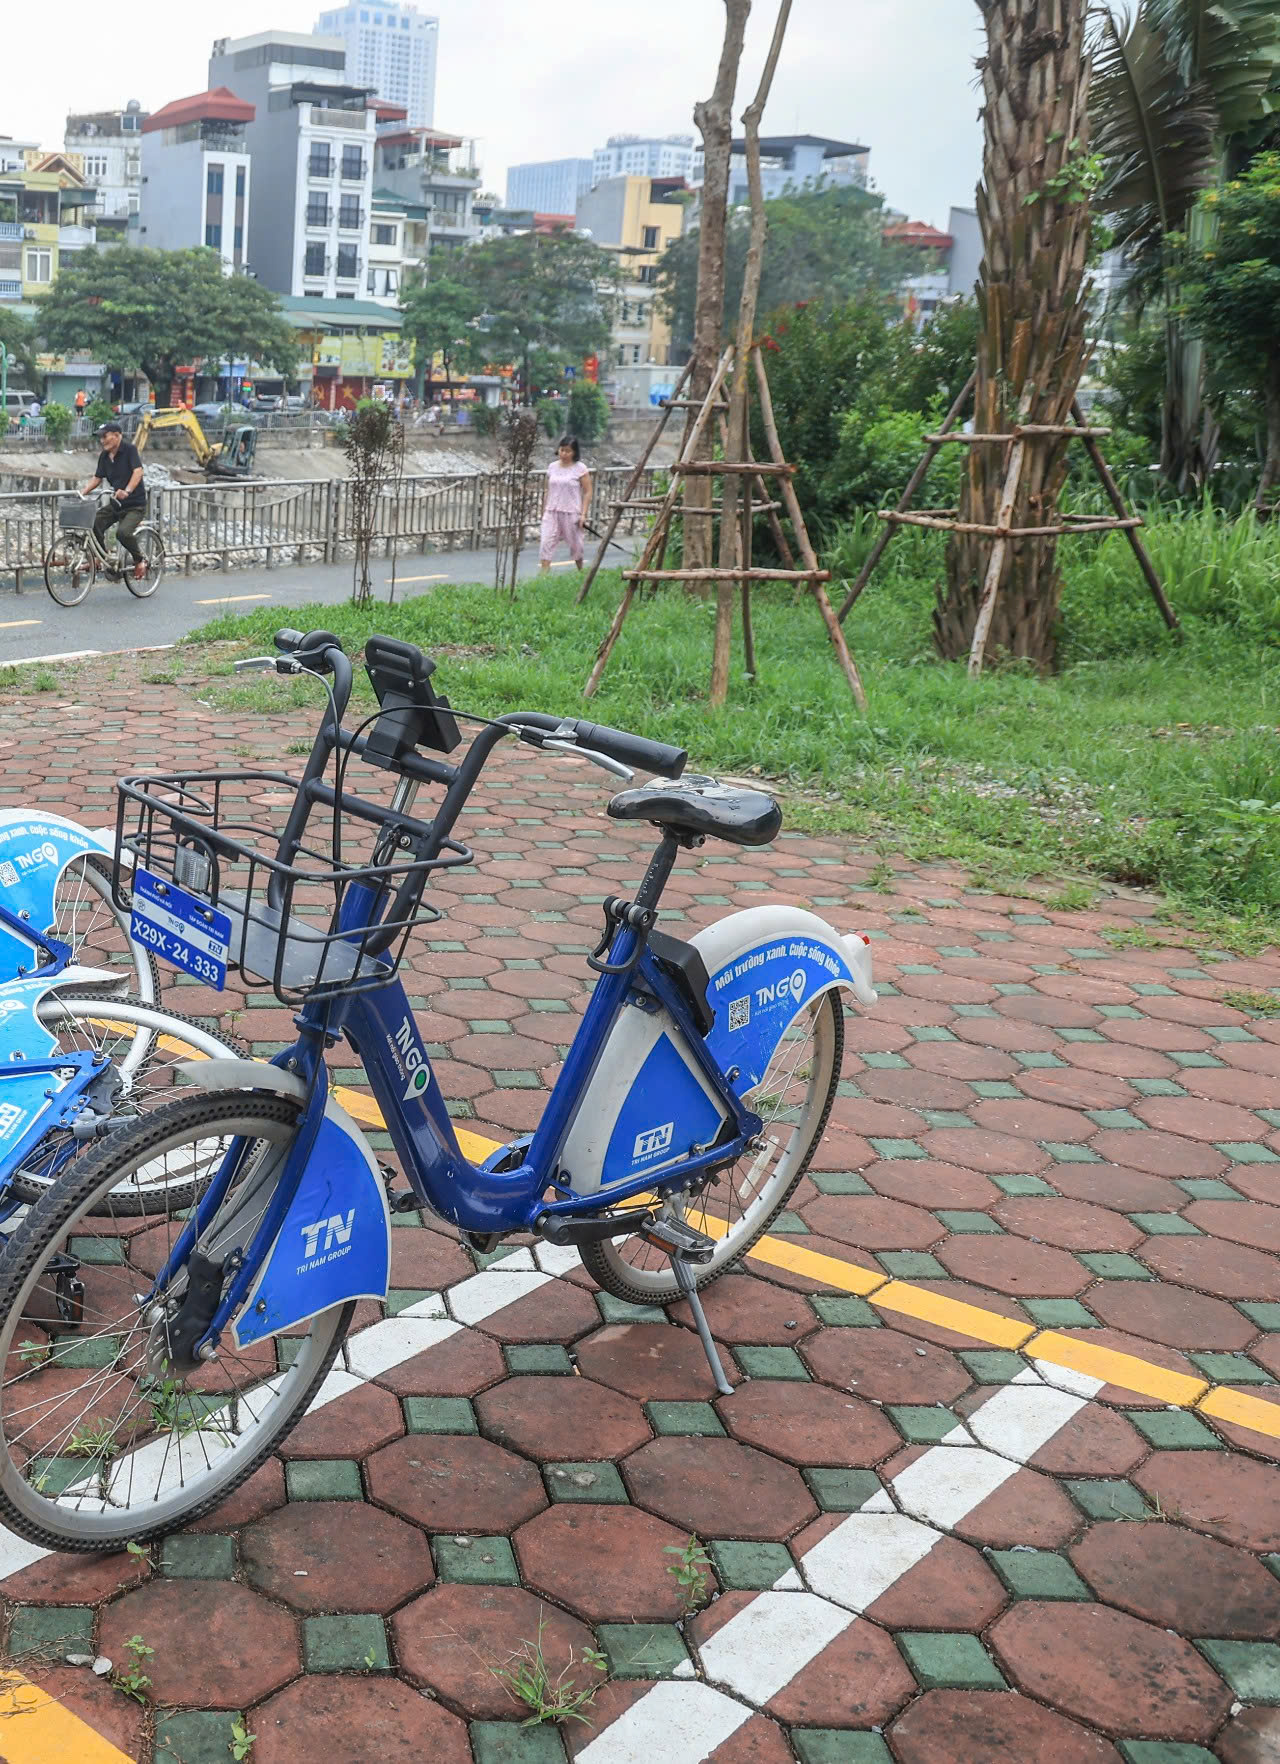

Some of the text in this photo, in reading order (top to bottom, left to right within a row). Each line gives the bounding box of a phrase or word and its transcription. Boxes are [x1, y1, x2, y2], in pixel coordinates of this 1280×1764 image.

[133, 917, 219, 982] X29X-24.333
[715, 969, 734, 992] Môi
[735, 952, 765, 977] trường
[765, 944, 788, 961] xanh.
[789, 941, 808, 959] Cuộc
[807, 945, 826, 966] sống
[301, 1208, 355, 1258] TN
[296, 1245, 352, 1275] TRI NAM GROUP
